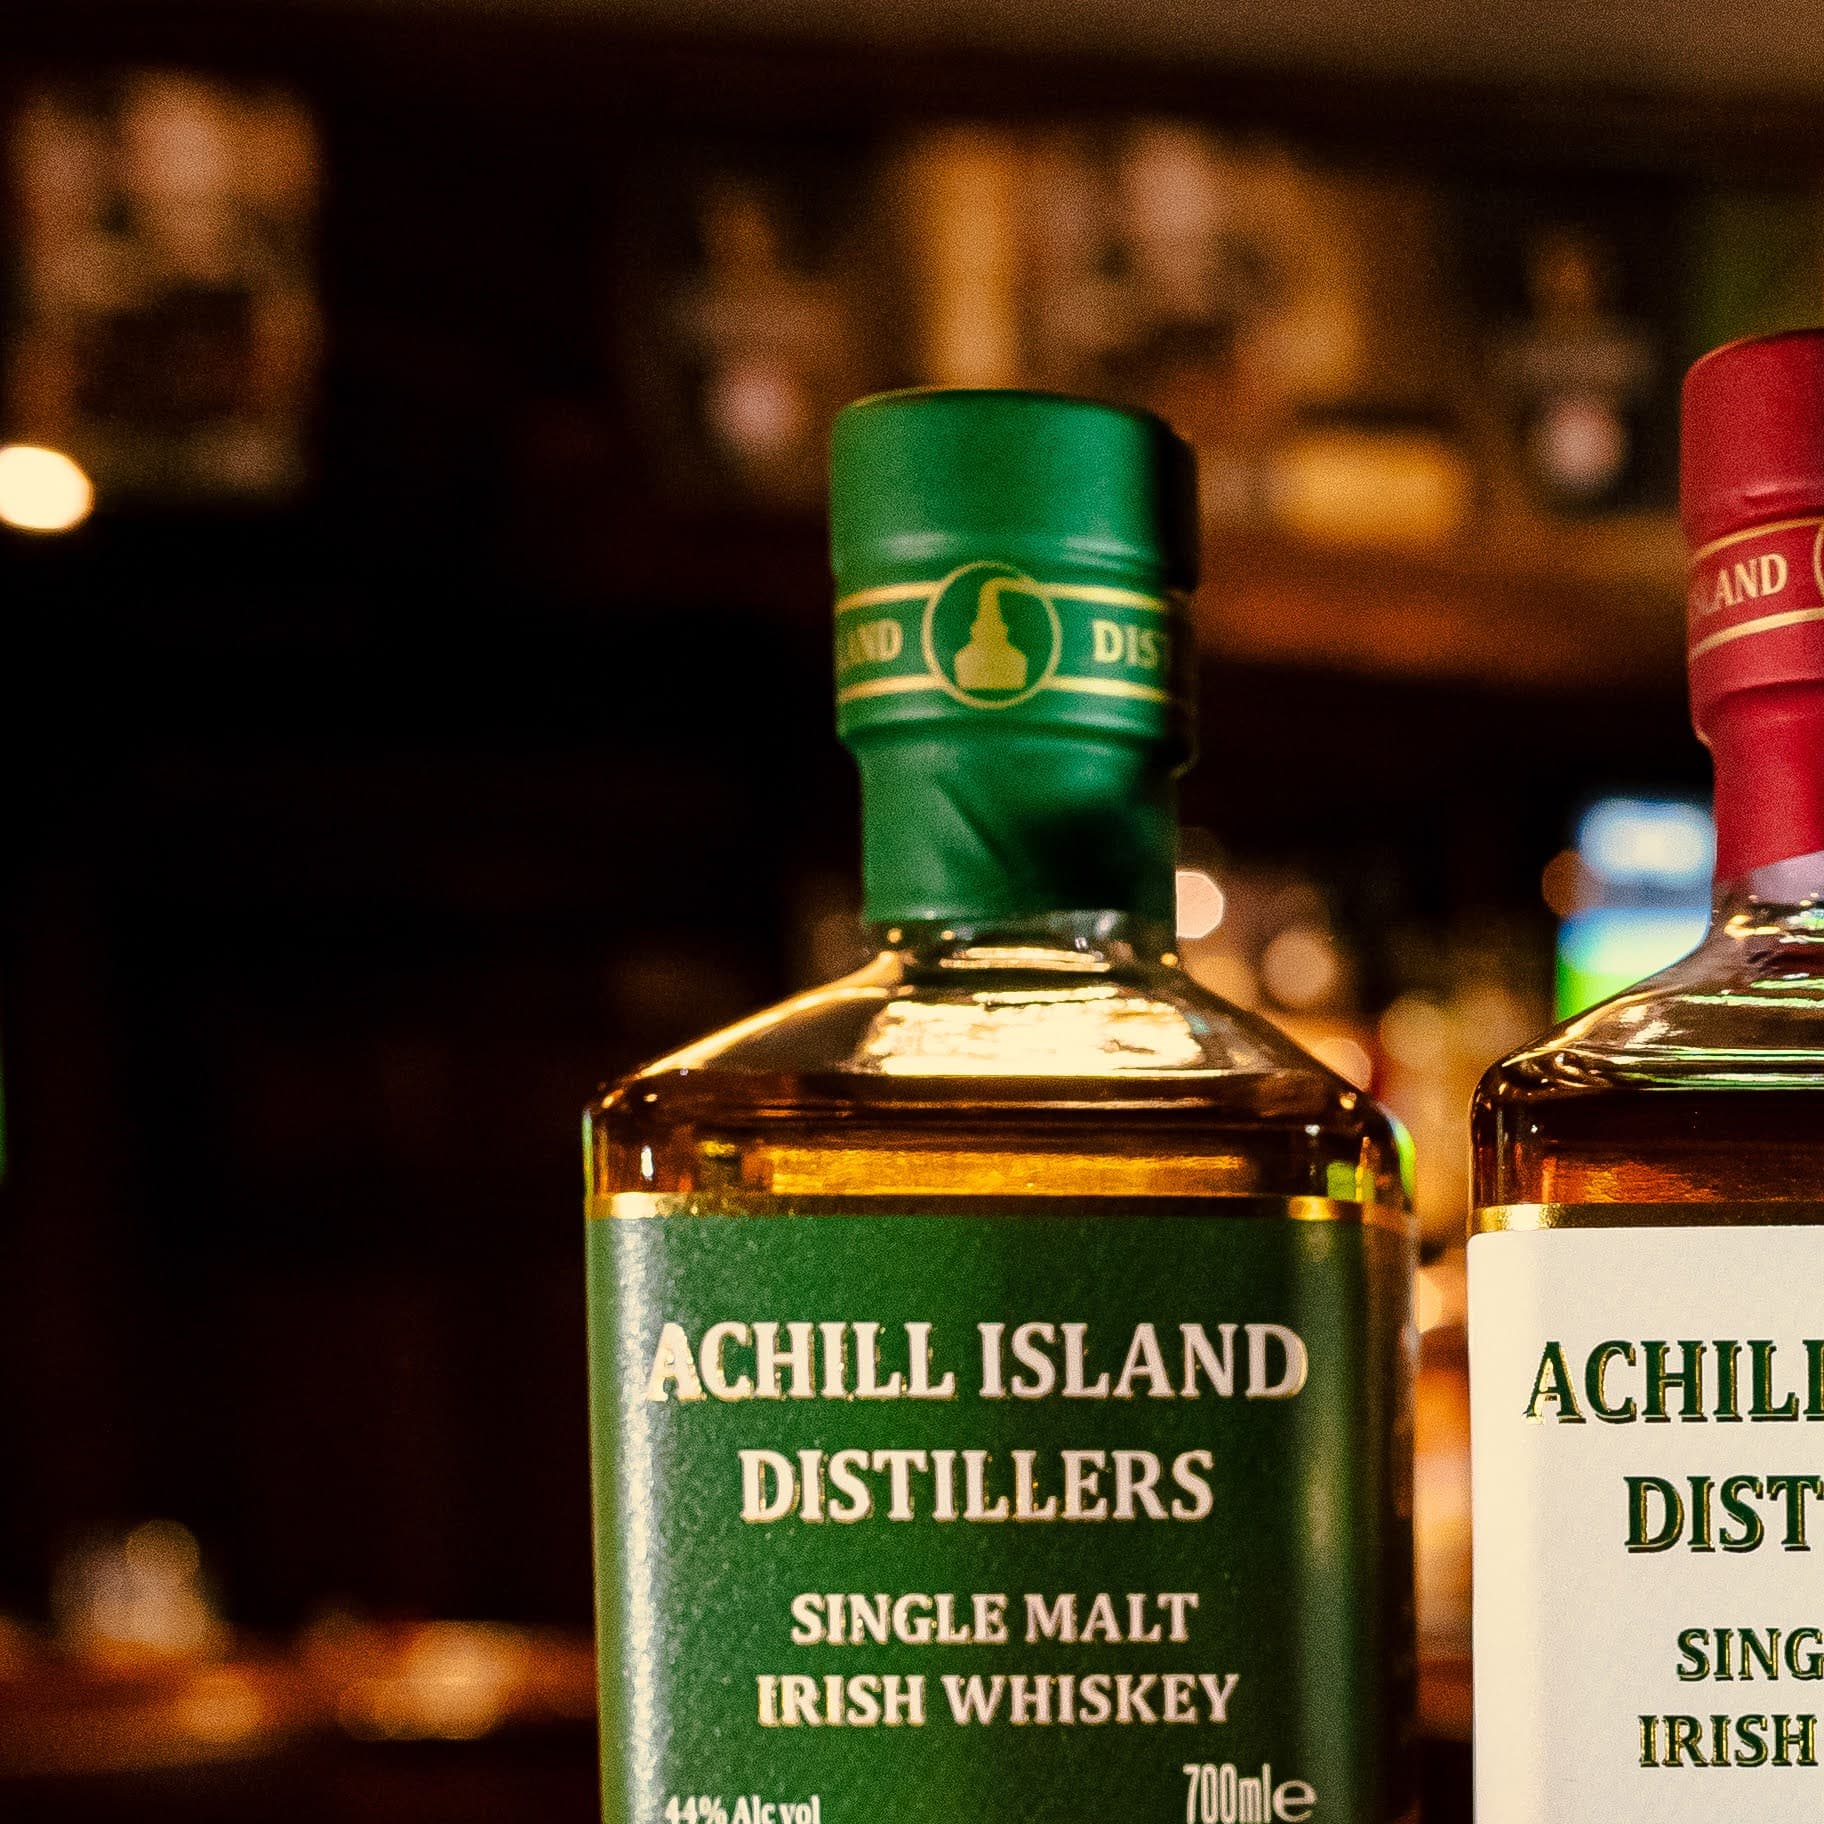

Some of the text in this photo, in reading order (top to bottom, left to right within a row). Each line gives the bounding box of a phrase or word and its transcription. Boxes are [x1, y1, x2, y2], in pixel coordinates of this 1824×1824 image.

[646, 1322, 1308, 1402] ACHILL ISLAND
[740, 1449, 1214, 1523] DISTILLERS
[790, 1592, 1199, 1645] SINGLE MALT
[757, 1672, 1240, 1728] IRISH WHISKEY
[1638, 1713, 1817, 1768] IRISH
